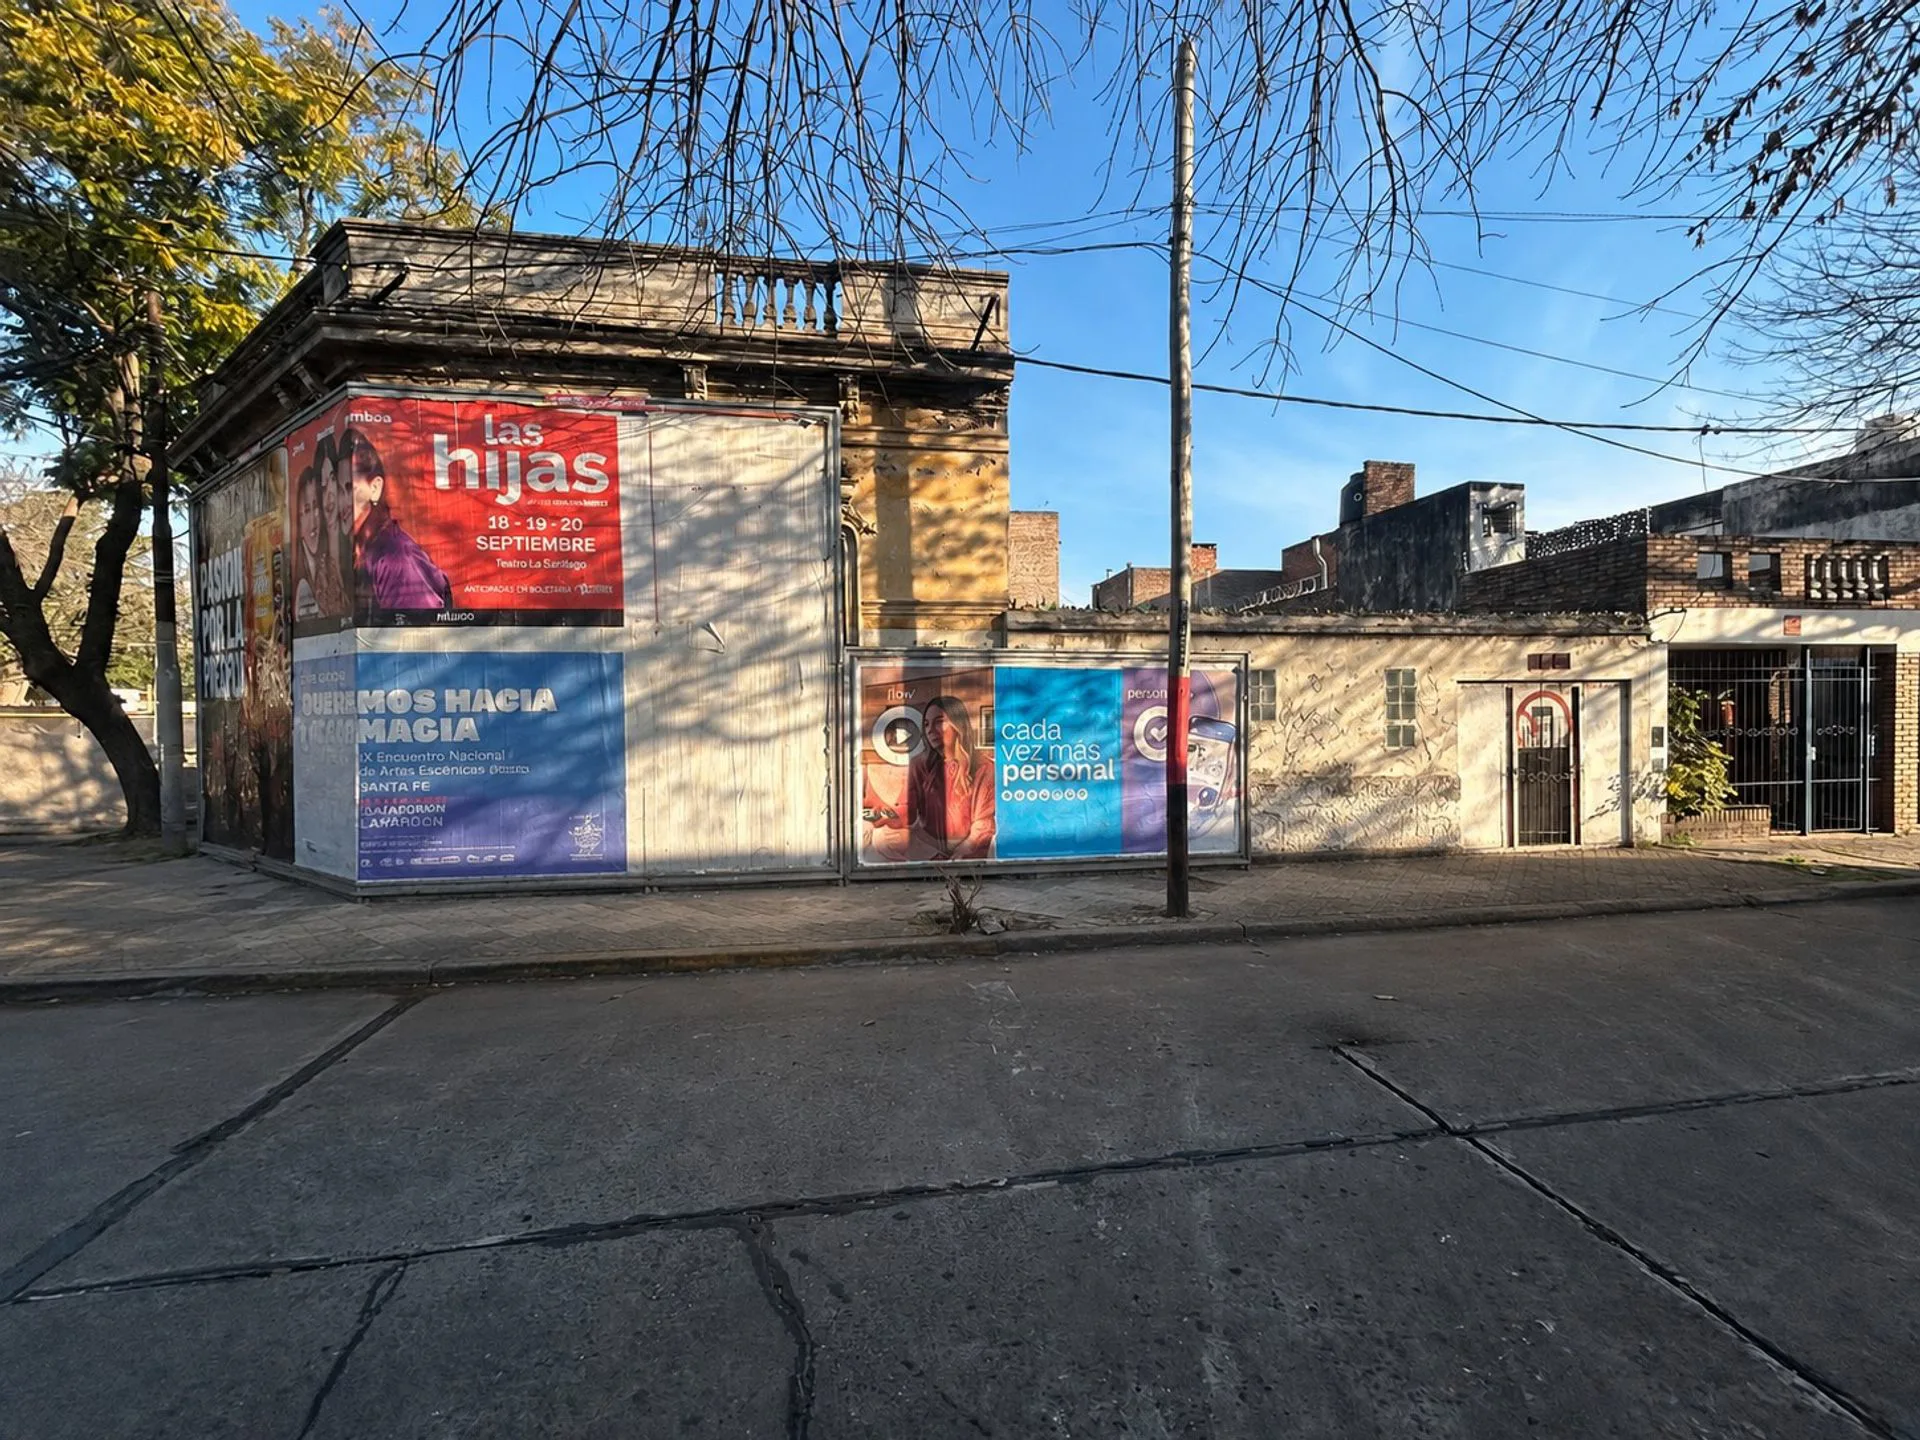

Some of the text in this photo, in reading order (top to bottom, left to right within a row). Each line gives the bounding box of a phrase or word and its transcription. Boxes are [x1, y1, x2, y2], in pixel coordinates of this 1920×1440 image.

[433, 433, 610, 505] hijas
[488, 516, 510, 530] 18
[526, 517, 547, 531] 19
[560, 518, 583, 532] 20
[476, 536, 596, 552] SEPTIEMBRE
[202, 599, 244, 653] POR LA
[1001, 718, 1062, 741] cada
[449, 750, 506, 762] Nacional
[1001, 740, 1101, 762] vez más
[1002, 758, 1115, 787] personal
[360, 781, 431, 793] SANTA FE
